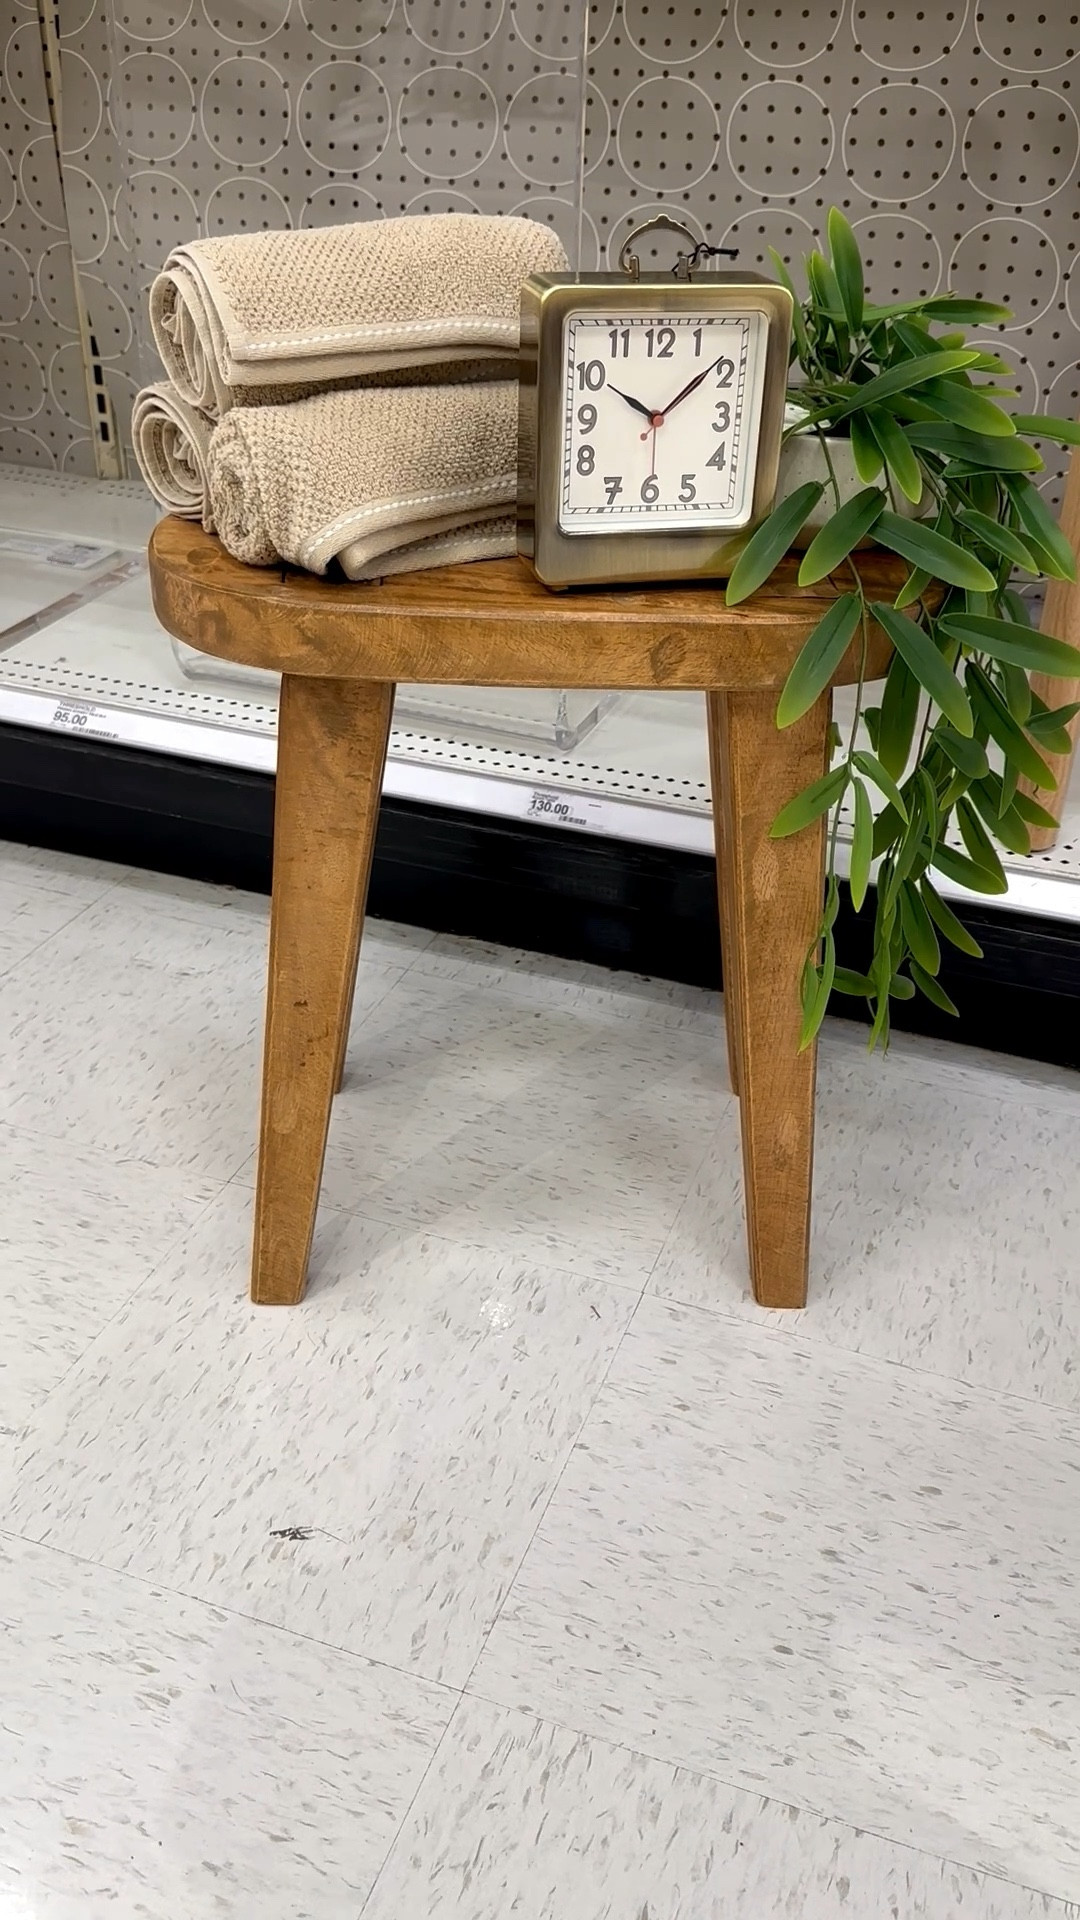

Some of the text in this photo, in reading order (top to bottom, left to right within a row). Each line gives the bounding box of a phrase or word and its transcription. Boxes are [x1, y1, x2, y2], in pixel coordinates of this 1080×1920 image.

[608, 327, 702, 358] 11 12 1
[576, 359, 606, 391] 10
[716, 358, 735, 389] 2
[577, 403, 598, 435] 9
[711, 401, 731, 433] 3
[576, 444, 595, 476] 8
[705, 441, 726, 471] 4
[603, 474, 697, 505] 7 6 5
[52, 710, 88, 726] 95.00
[530, 799, 570, 815] 130.00
